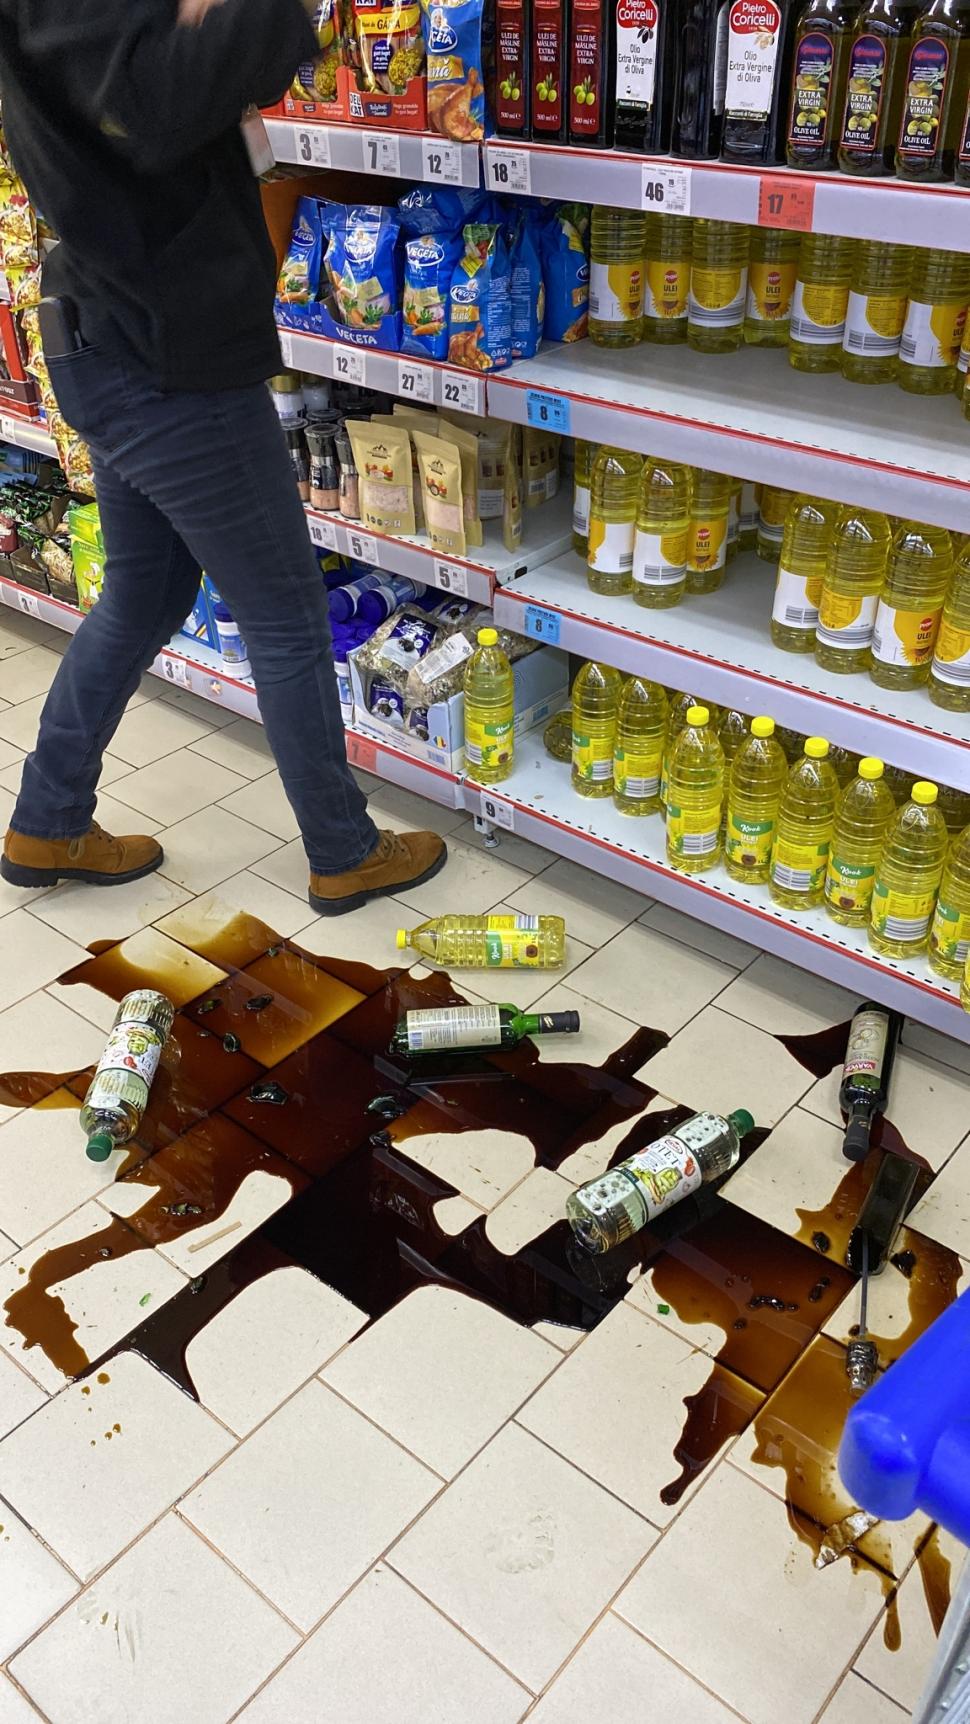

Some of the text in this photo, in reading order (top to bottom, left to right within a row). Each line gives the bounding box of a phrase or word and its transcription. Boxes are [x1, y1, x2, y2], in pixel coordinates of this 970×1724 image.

[618, 8, 653, 21] Coricelli
[742, 3, 766, 13] Pietro
[732, 13, 775, 26] Coricelli
[629, 44, 641, 53] Olio
[577, 57, 594, 65] VIRGIN
[618, 54, 653, 67] Extra Vergine
[744, 51, 757, 61] Olio
[631, 65, 645, 75] Oliva
[729, 61, 772, 74] Extra Vergine
[737, 72, 761, 83] di Oliva
[798, 91, 821, 99] EXTRA
[851, 95, 873, 103] EXTRA
[798, 98, 820, 106] VIRGIN
[850, 102, 872, 110] VIRGIN
[911, 98, 934, 107] EXTRA
[910, 106, 933, 115] VIRGIN
[794, 126, 820, 136] OLIVE OIL
[845, 130, 870, 140] OLIVE OIL
[904, 136, 931, 145] OLIVE OIL
[300, 133, 312, 162] 3
[368, 141, 378, 169] 7
[428, 154, 442, 174] 12
[492, 163, 508, 183] 18
[645, 182, 664, 202] 46
[768, 193, 784, 214] 17
[406, 245, 438, 259] VEGETA
[663, 285, 678, 293] ULEI
[766, 286, 780, 294] ULEI
[335, 327, 377, 345] VEGETA
[336, 356, 348, 373] 12
[402, 373, 415, 392] 27
[445, 383, 460, 402] 22
[540, 405, 548, 421] 8
[310, 526, 323, 541] 18
[352, 536, 363, 557] 5
[439, 568, 450, 588] 5
[535, 618, 542, 633] 8
[165, 661, 174, 679] 3
[485, 801, 496, 818] 9
